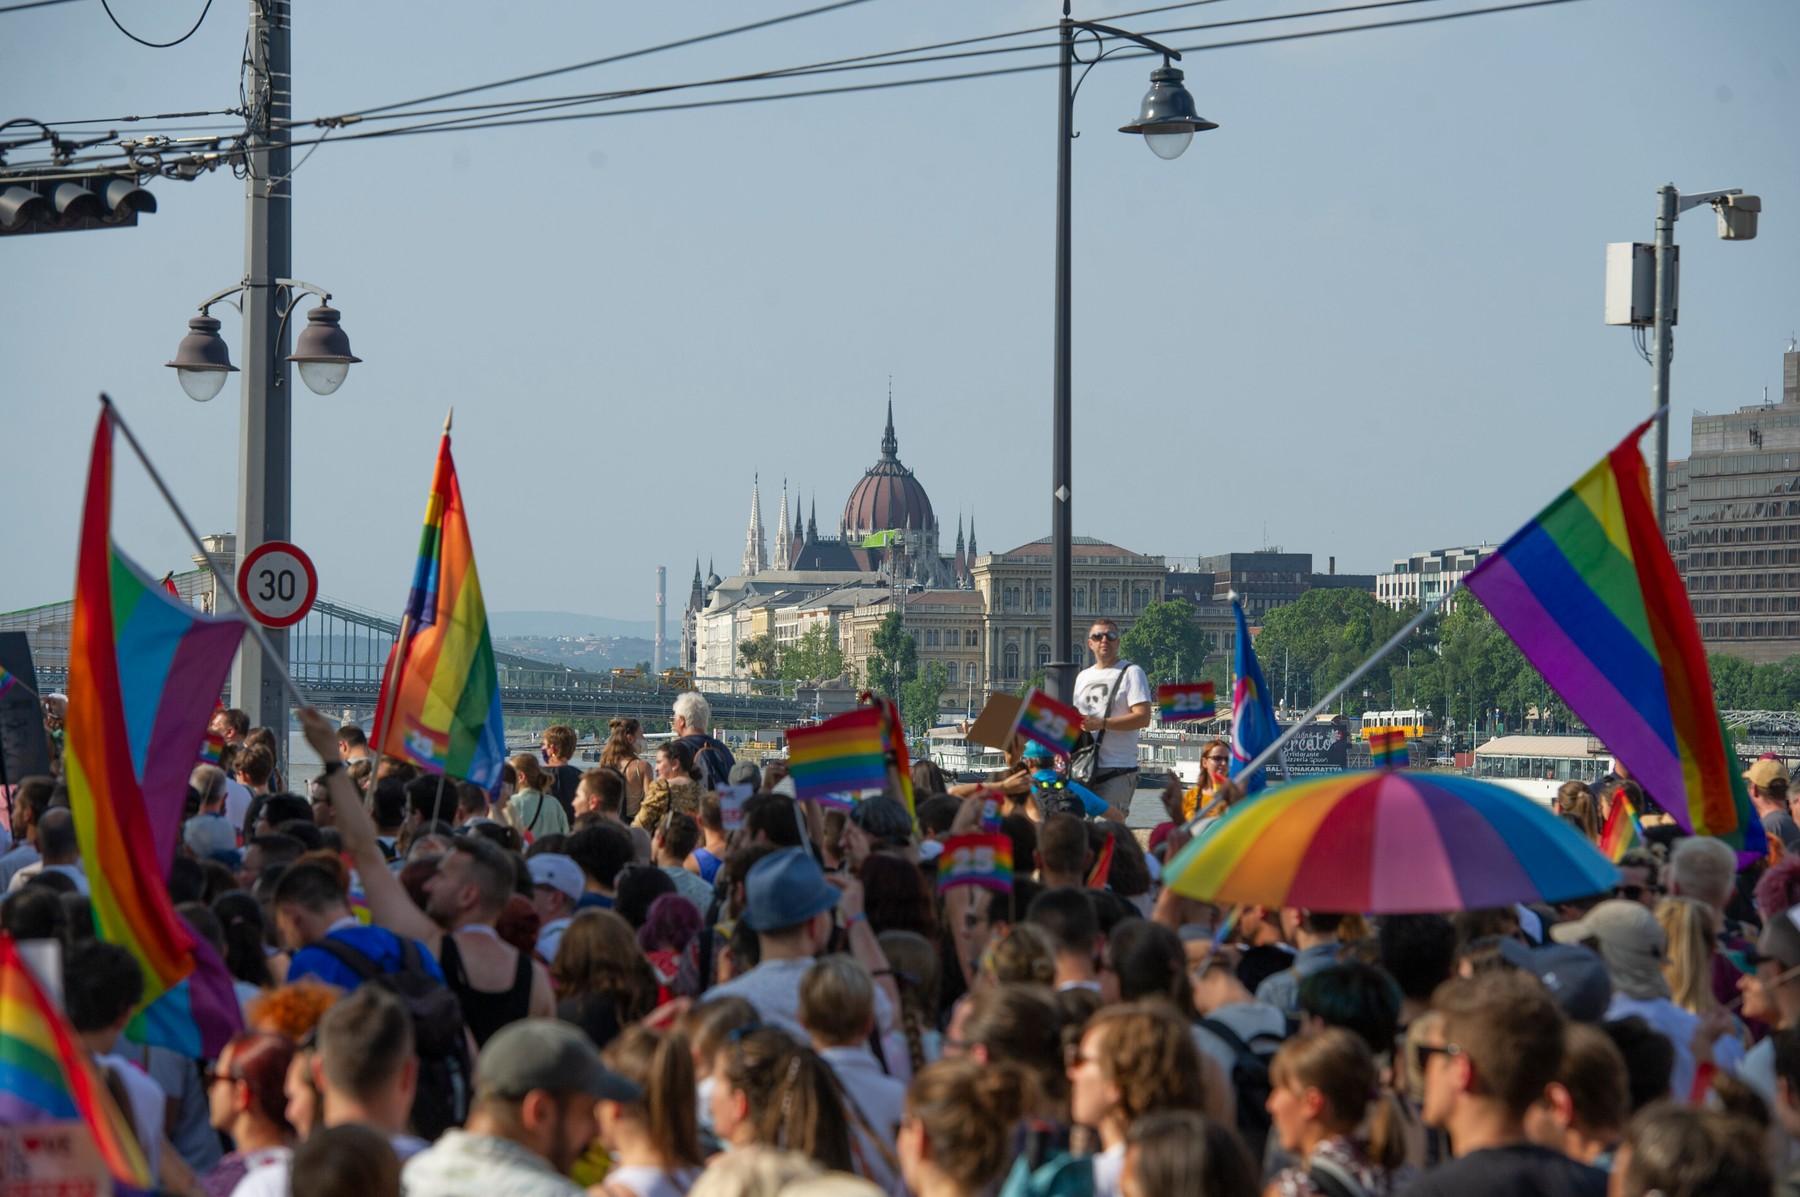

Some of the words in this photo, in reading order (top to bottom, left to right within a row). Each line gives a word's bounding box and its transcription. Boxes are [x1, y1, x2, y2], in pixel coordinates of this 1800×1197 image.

[259, 570, 295, 602] 30
[1173, 692, 1203, 712] 25
[1034, 708, 1069, 740] 25
[1283, 732, 1331, 751] ercato
[951, 845, 995, 875] 25
